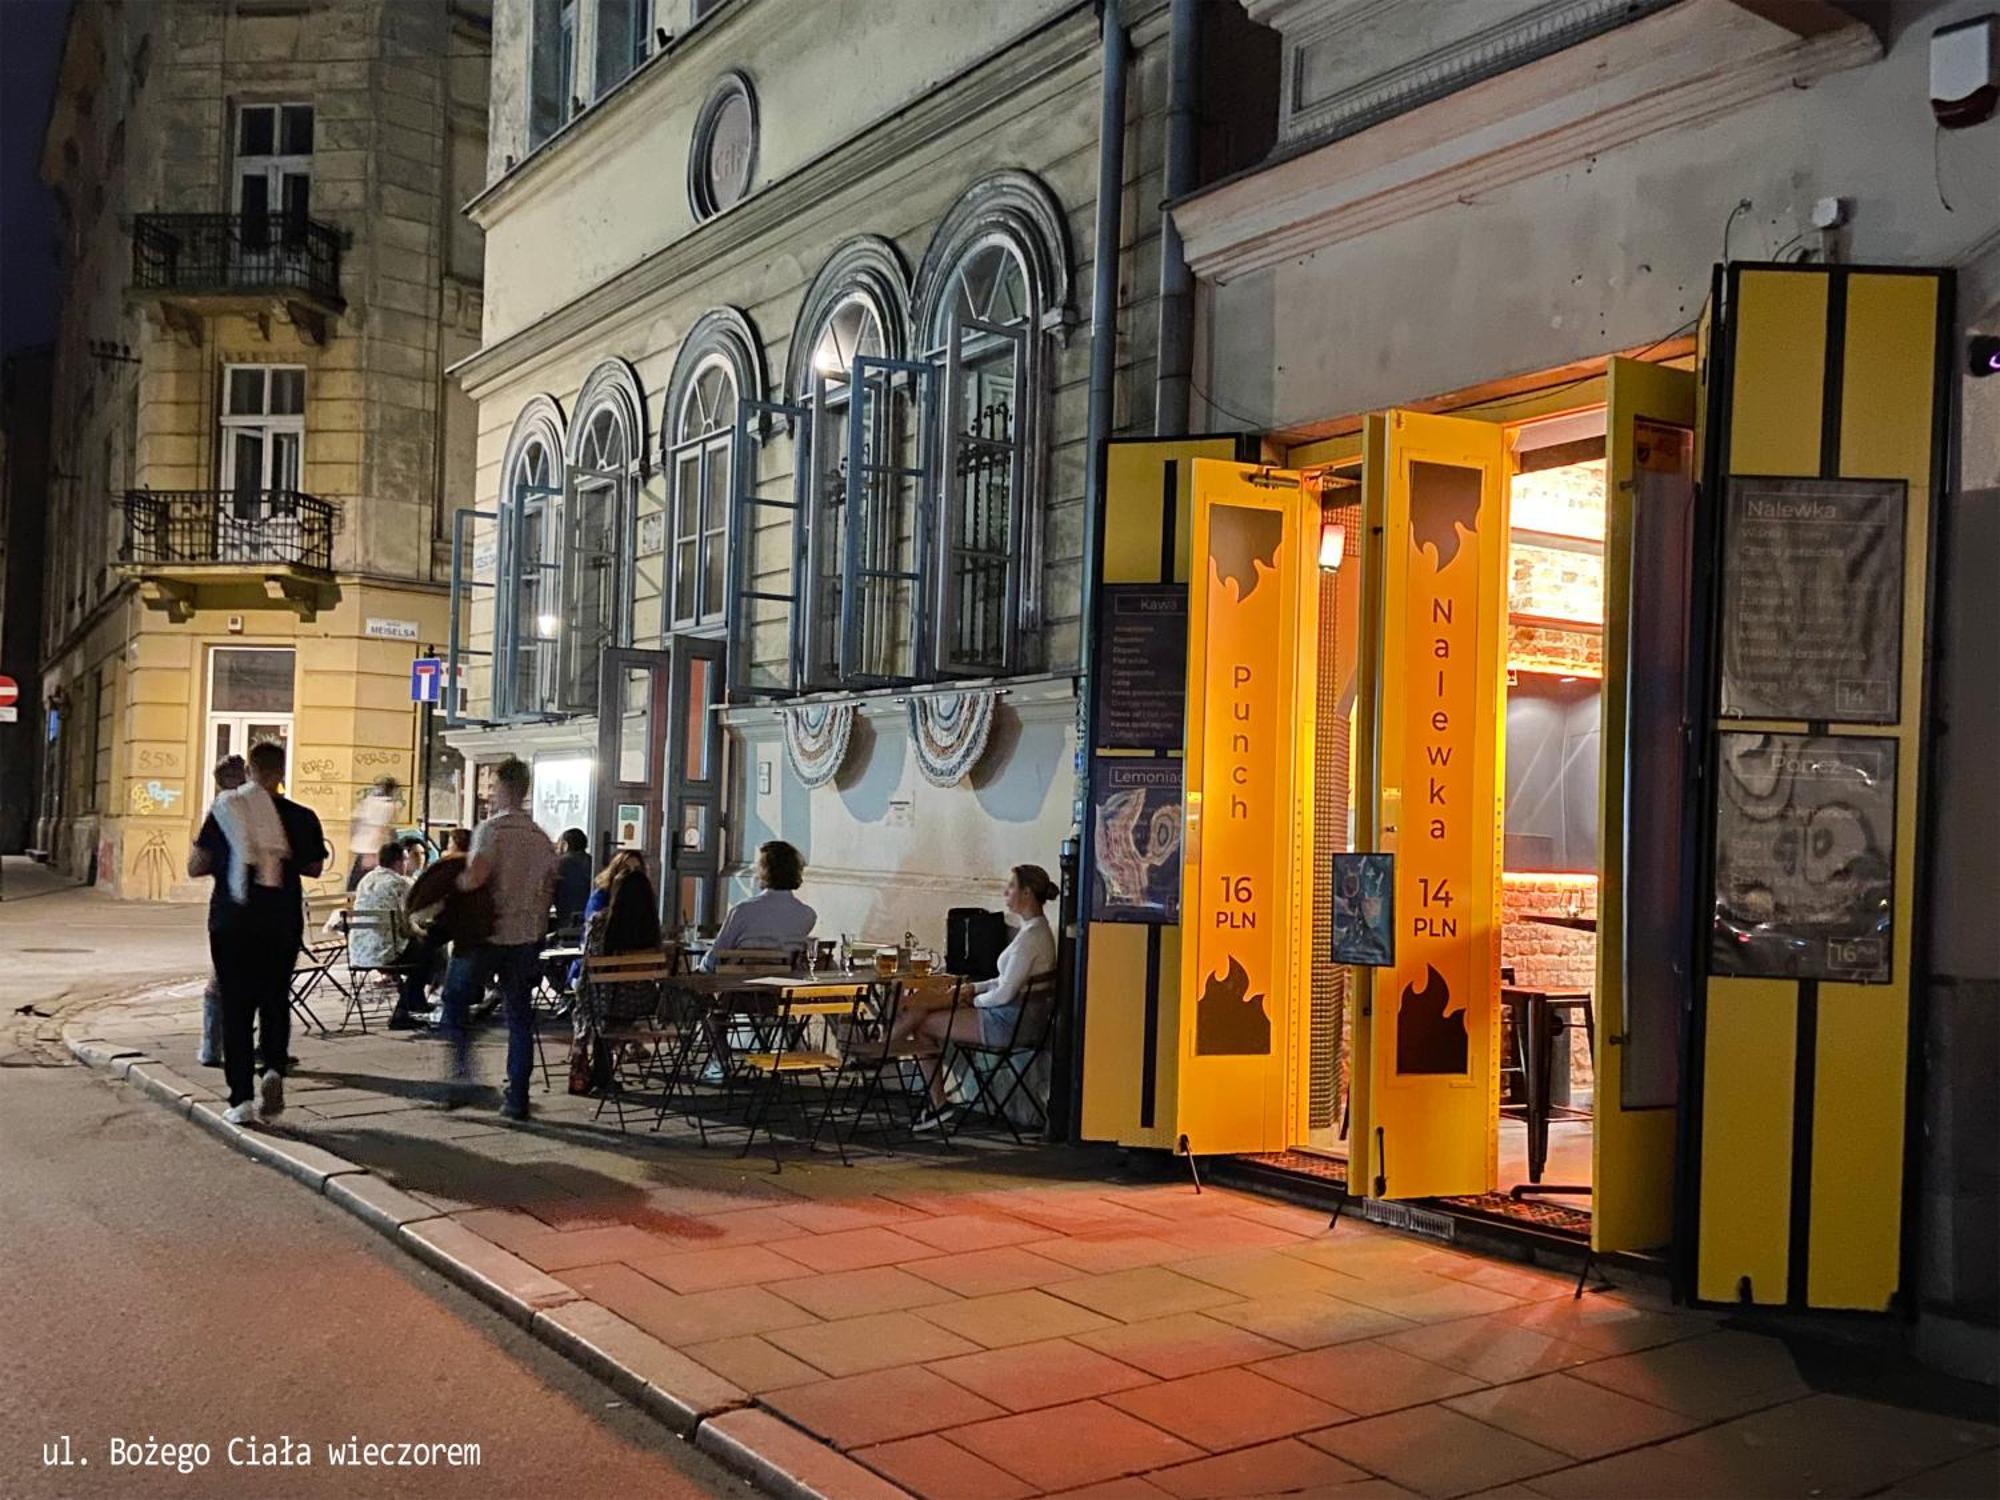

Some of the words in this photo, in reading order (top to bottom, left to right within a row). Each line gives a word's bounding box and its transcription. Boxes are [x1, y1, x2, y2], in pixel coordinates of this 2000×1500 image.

[1747, 501, 1837, 520] Nalewka
[1140, 598, 1178, 611] Kawa
[370, 625, 416, 638] MEISELSA
[1426, 597, 1453, 840] Nalewka
[1231, 665, 1252, 820] Punch
[1220, 876, 1253, 904] 16
[1417, 878, 1454, 908] 14
[1215, 911, 1257, 930] PLN
[1413, 917, 1458, 938] PLN
[1834, 943, 1858, 962] 16
